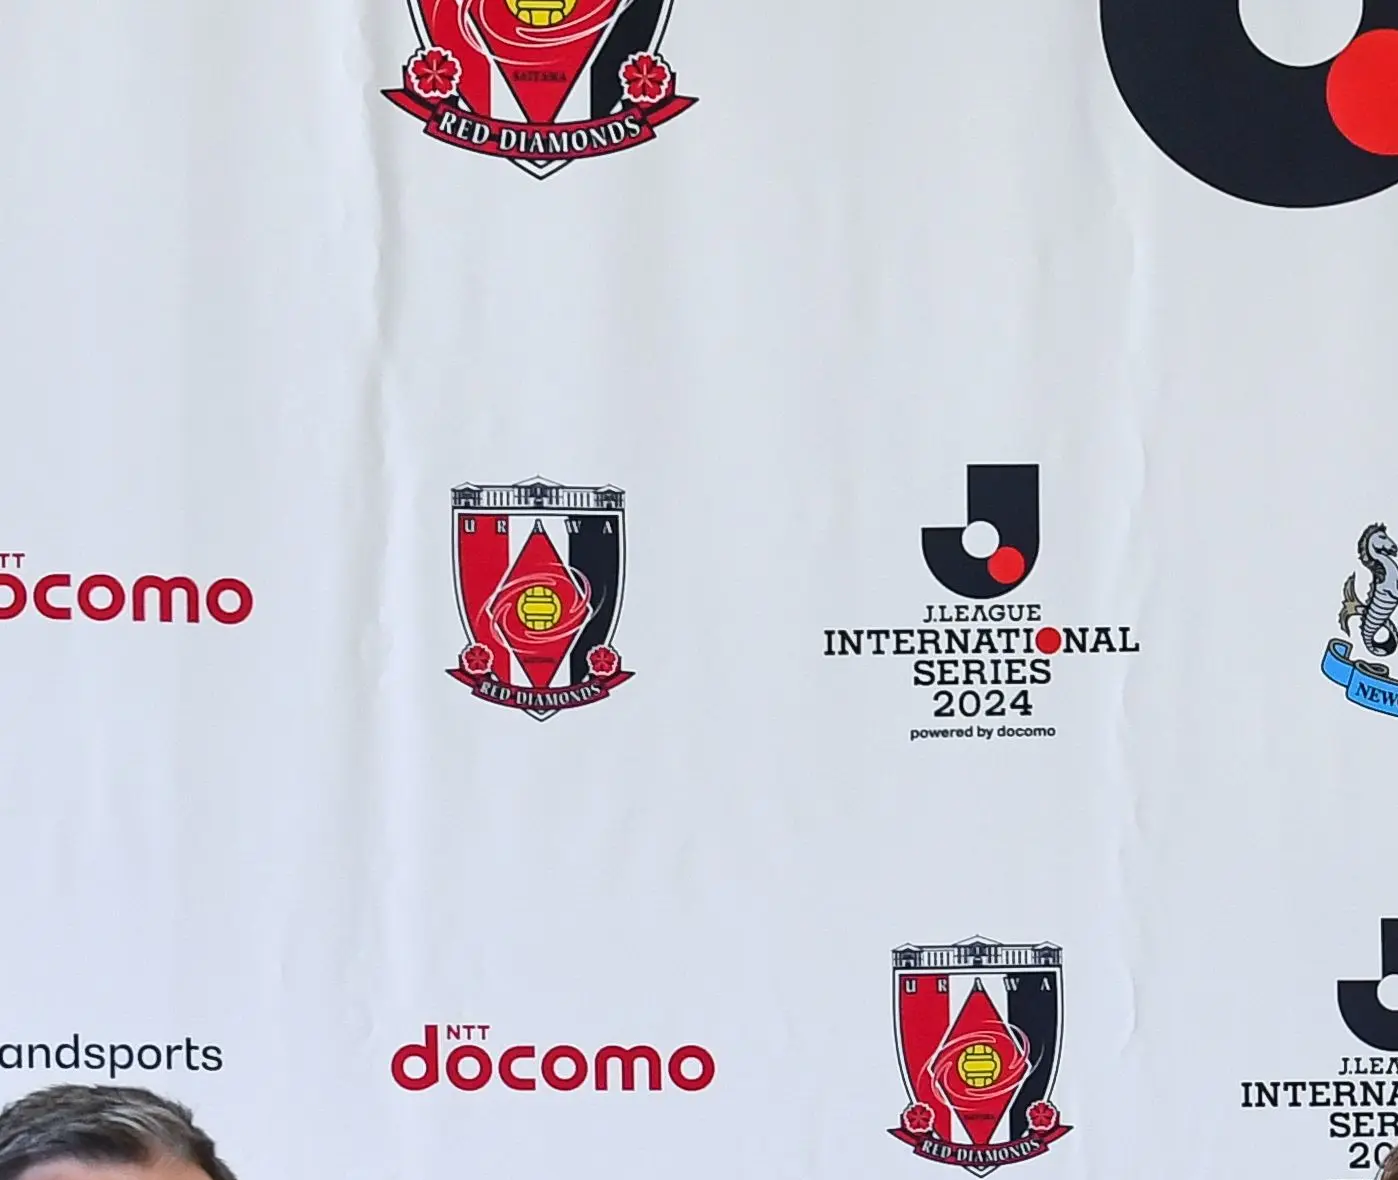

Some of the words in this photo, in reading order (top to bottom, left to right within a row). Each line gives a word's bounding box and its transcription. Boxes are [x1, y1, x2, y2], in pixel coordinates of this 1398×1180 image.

[439, 111, 490, 144] RED
[500, 117, 641, 153] DIAMONDS
[0, 553, 25, 568] TT
[0, 573, 254, 626] ocomo
[923, 604, 1041, 624] J.LEAGUE
[913, 659, 1051, 686] SERIES
[480, 681, 512, 703] RED
[516, 684, 602, 708] DIAMONDS
[933, 690, 1033, 717] 2024
[910, 726, 973, 741] powered
[976, 726, 994, 740] by
[997, 725, 1056, 738] docomo
[446, 1024, 491, 1040] NTT
[0, 1034, 224, 1078] andsports
[390, 1024, 716, 1091] docomo
[922, 1140, 952, 1160] RED
[957, 1139, 1041, 1163] DIAMONDS
